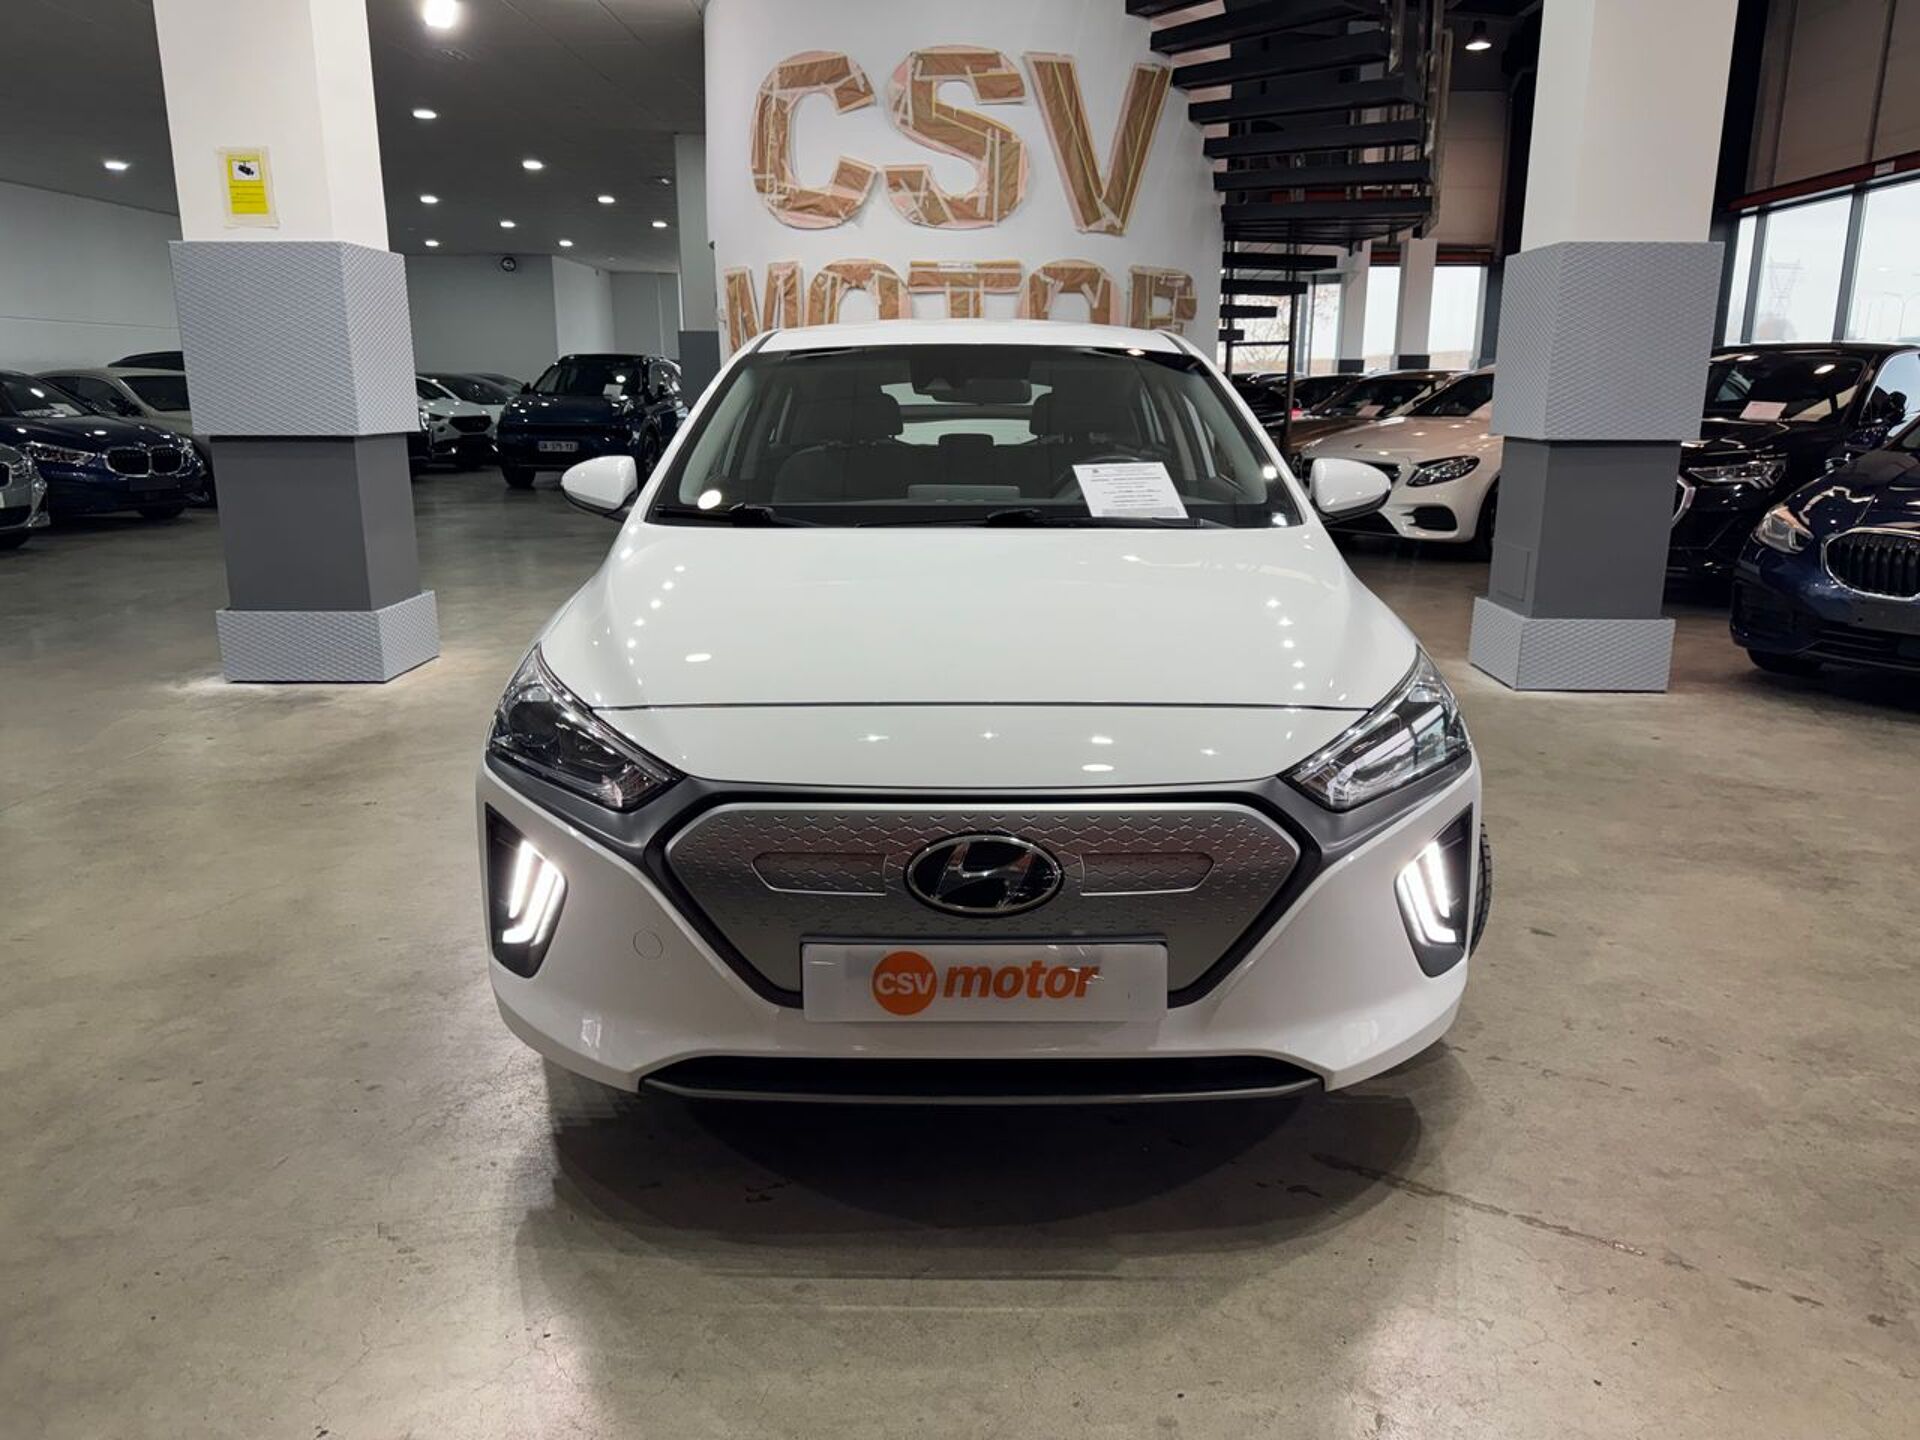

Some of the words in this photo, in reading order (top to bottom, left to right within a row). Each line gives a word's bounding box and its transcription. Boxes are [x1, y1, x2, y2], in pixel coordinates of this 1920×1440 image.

[751, 44, 1172, 235] CSV
[876, 972, 934, 995] CSV
[943, 960, 1099, 999] motor
